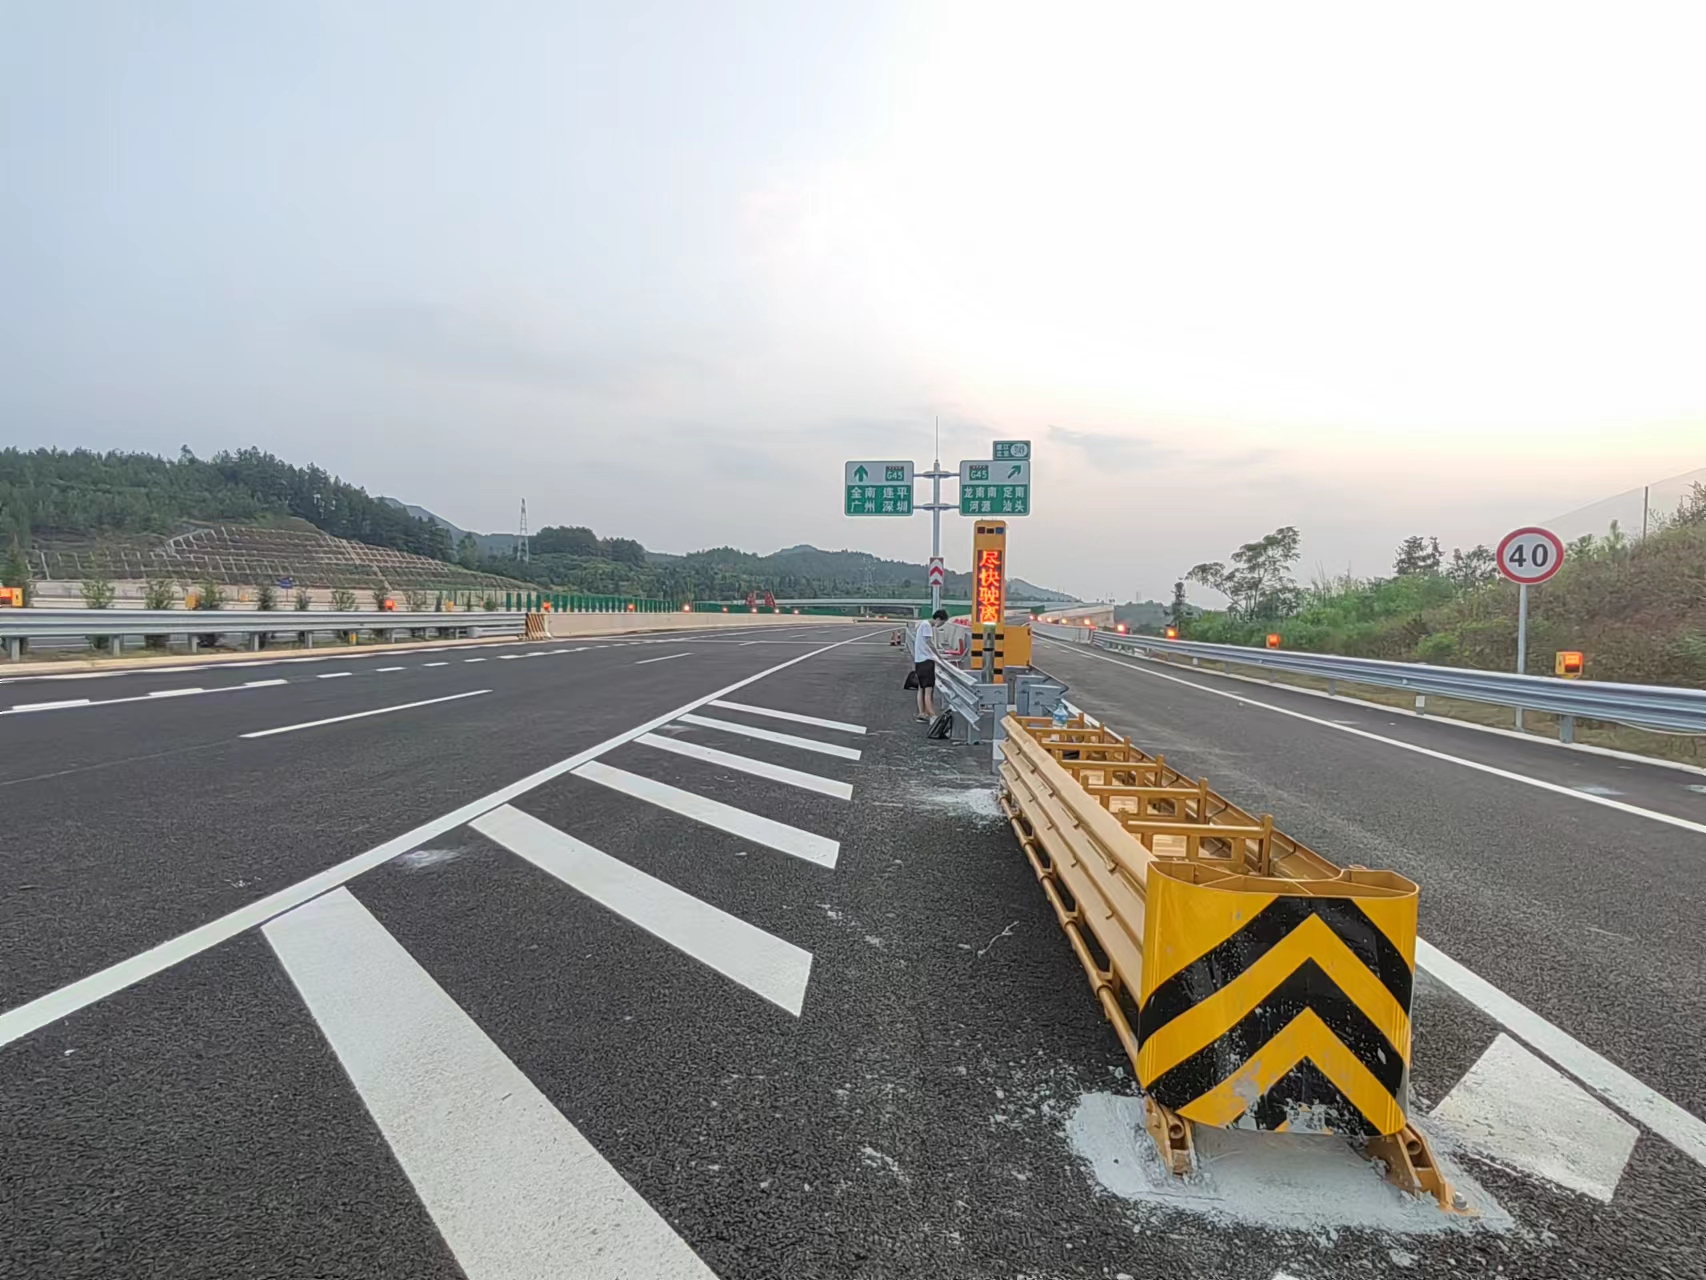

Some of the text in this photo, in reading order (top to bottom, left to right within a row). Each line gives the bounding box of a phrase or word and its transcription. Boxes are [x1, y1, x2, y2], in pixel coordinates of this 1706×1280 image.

[886, 471, 903, 480] G45
[970, 470, 987, 479] G45
[850, 486, 876, 499] 全南
[850, 500, 908, 513] 广州 深圳
[969, 500, 1025, 512] 河源 汕头
[1508, 543, 1549, 568] 40
[979, 550, 1001, 622] 尽快驶离
